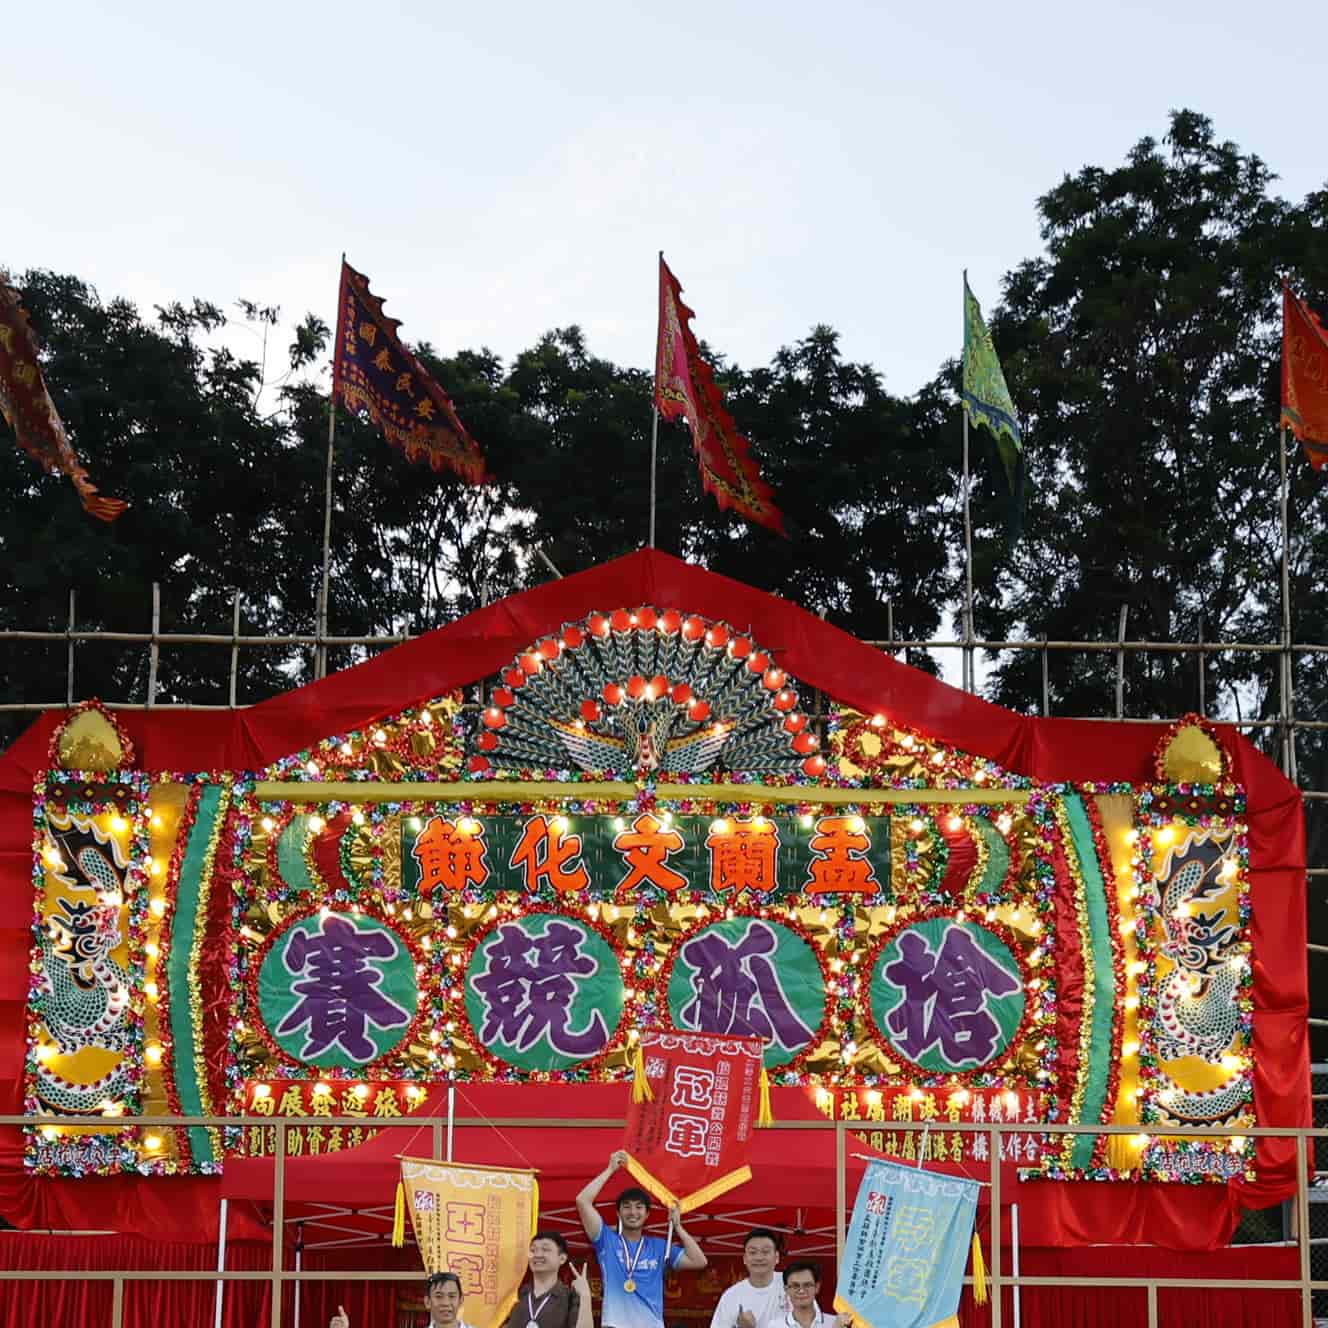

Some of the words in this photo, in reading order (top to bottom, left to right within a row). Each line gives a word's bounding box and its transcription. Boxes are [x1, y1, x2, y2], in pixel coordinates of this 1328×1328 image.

[411, 814, 881, 896] 盂蘭文化節
[665, 1065, 715, 1157] 冠軍
